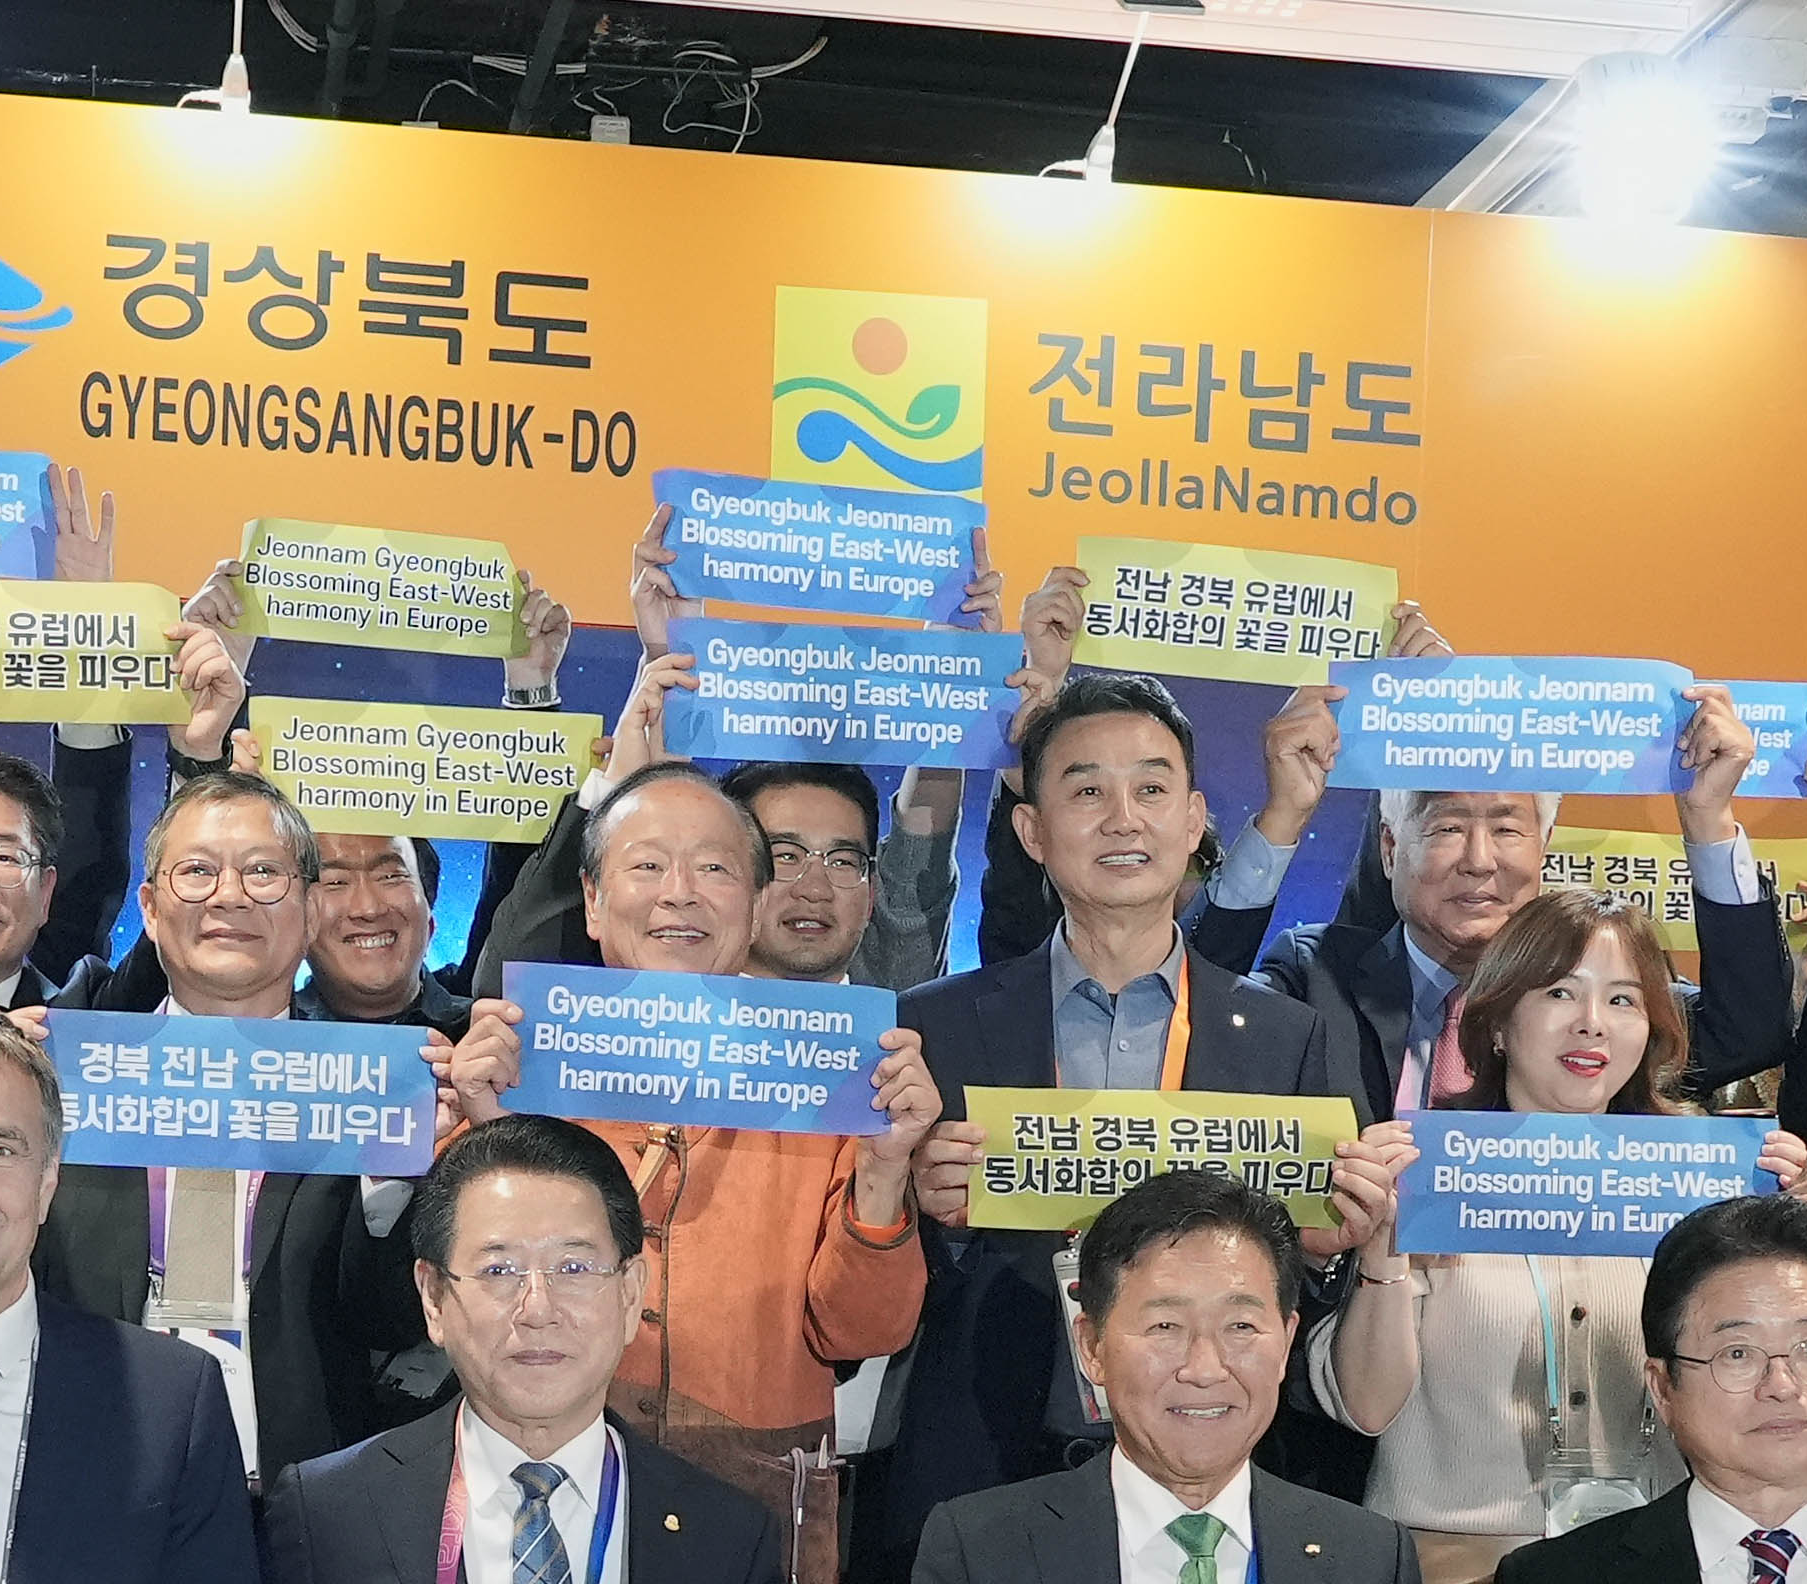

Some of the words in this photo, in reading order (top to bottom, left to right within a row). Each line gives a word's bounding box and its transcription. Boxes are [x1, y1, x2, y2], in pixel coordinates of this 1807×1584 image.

[103, 233, 591, 369] 경상북도
[1029, 332, 1421, 453] 전라남도
[80, 371, 636, 477] GYEONGSANGBUK-DO
[1028, 451, 1417, 525] JeollaNamdo
[1115, 566, 1172, 603] 전남
[1179, 574, 1234, 610] 경북
[1244, 580, 1353, 621] 유럽에서
[7, 611, 136, 649] 유럽에서
[1086, 603, 1225, 647] 동서화합의
[1234, 618, 1289, 653] 꽃을
[1298, 624, 1380, 661] 피우다
[3, 653, 67, 690] 꽃을
[79, 655, 176, 691] 피우다
[707, 638, 854, 675] Gyeongbuk
[860, 649, 981, 677] Jeonnam
[698, 672, 847, 711] Blossoming
[854, 680, 989, 712] East-West
[1372, 672, 1522, 706] Gyeongbuk
[1529, 675, 1654, 702] Jeonnam
[282, 717, 408, 746] Jeonnam
[416, 724, 567, 756] Gyeongbuk
[722, 706, 838, 745] harmony
[845, 714, 867, 738] in
[874, 717, 963, 749] Europe
[1362, 705, 1509, 741] Blossoming
[1521, 708, 1661, 738] East-West
[272, 748, 426, 783] Blossoming
[435, 757, 576, 788] East-West
[1385, 741, 1501, 773] harmony
[1511, 744, 1533, 768] in
[1541, 745, 1634, 774] Europe
[297, 781, 416, 818] harmony
[425, 788, 448, 813] in
[456, 789, 549, 823] Europe
[548, 985, 710, 1029] Gyeongbuk
[718, 1000, 853, 1034] Jeonnam
[533, 1023, 700, 1067] Blossoming
[708, 1035, 860, 1071] East-West
[78, 1042, 150, 1085] 경북
[162, 1046, 238, 1088] 전남
[248, 1050, 388, 1095] 유럽에서
[559, 1061, 689, 1105] harmony
[696, 1071, 720, 1099] in
[728, 1074, 828, 1112] Europe
[62, 1092, 219, 1137] 동서화합의
[228, 1100, 300, 1142] 꽃을
[307, 1102, 416, 1145] 피우다
[1014, 1114, 1081, 1152] 전남
[1092, 1117, 1157, 1152] 경북
[1169, 1119, 1301, 1154] 유럽에서
[1444, 1130, 1601, 1166] Gyeongbuk
[1607, 1134, 1736, 1164] Jeonnam
[1243, 1160, 1333, 1196] 피우다
[1434, 1165, 1593, 1203] Blossoming
[1601, 1169, 1745, 1199] East-West
[1459, 1202, 1583, 1238] harmony
[1591, 1205, 1615, 1232] in
